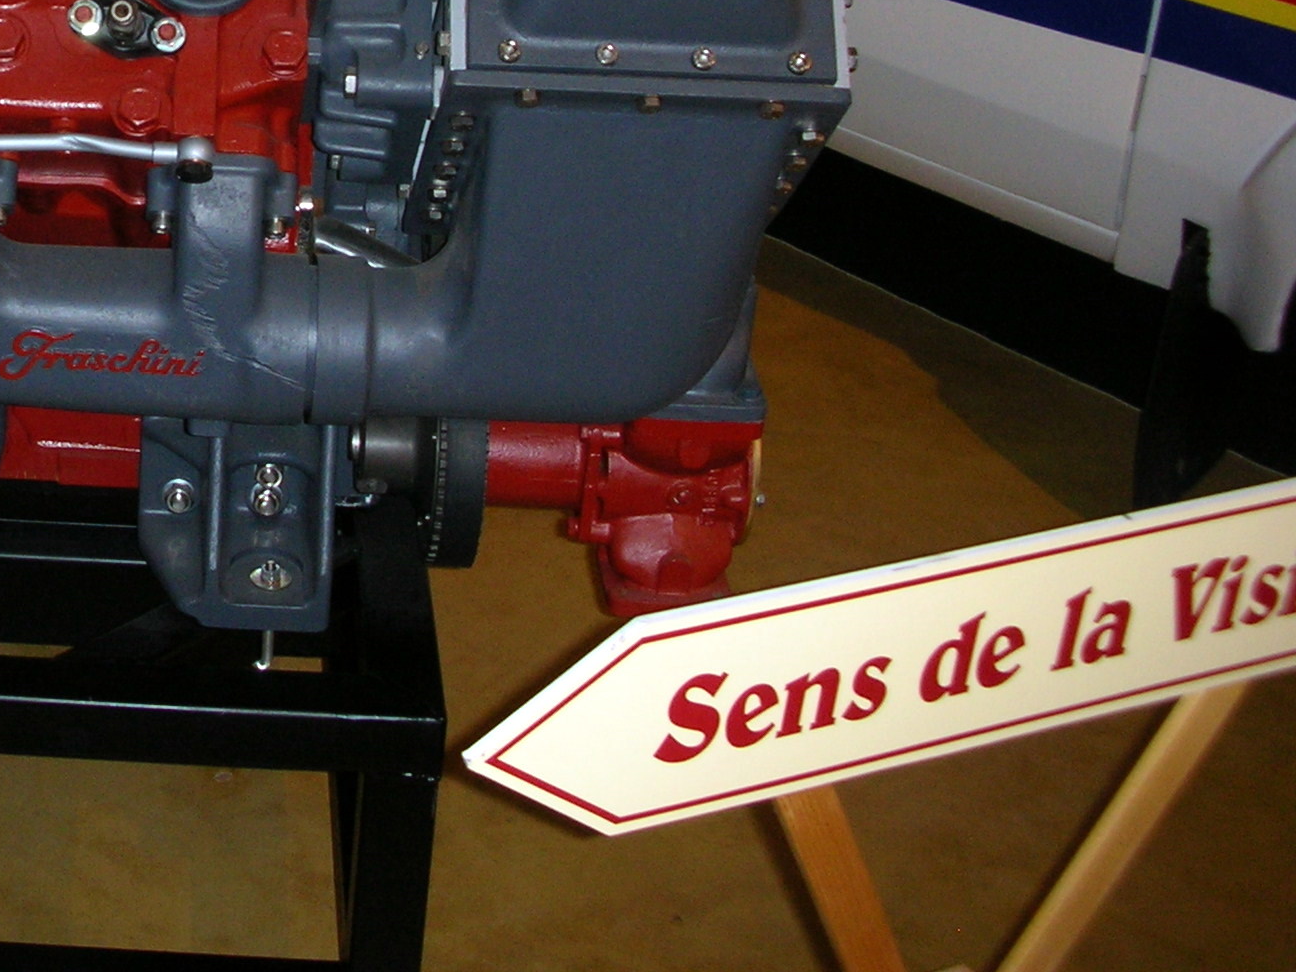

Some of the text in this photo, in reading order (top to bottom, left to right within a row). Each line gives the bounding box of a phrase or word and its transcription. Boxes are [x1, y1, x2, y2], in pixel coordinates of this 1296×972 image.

[654, 653, 894, 763] Sens
[919, 611, 1026, 703] de
[1051, 586, 1133, 672] la
